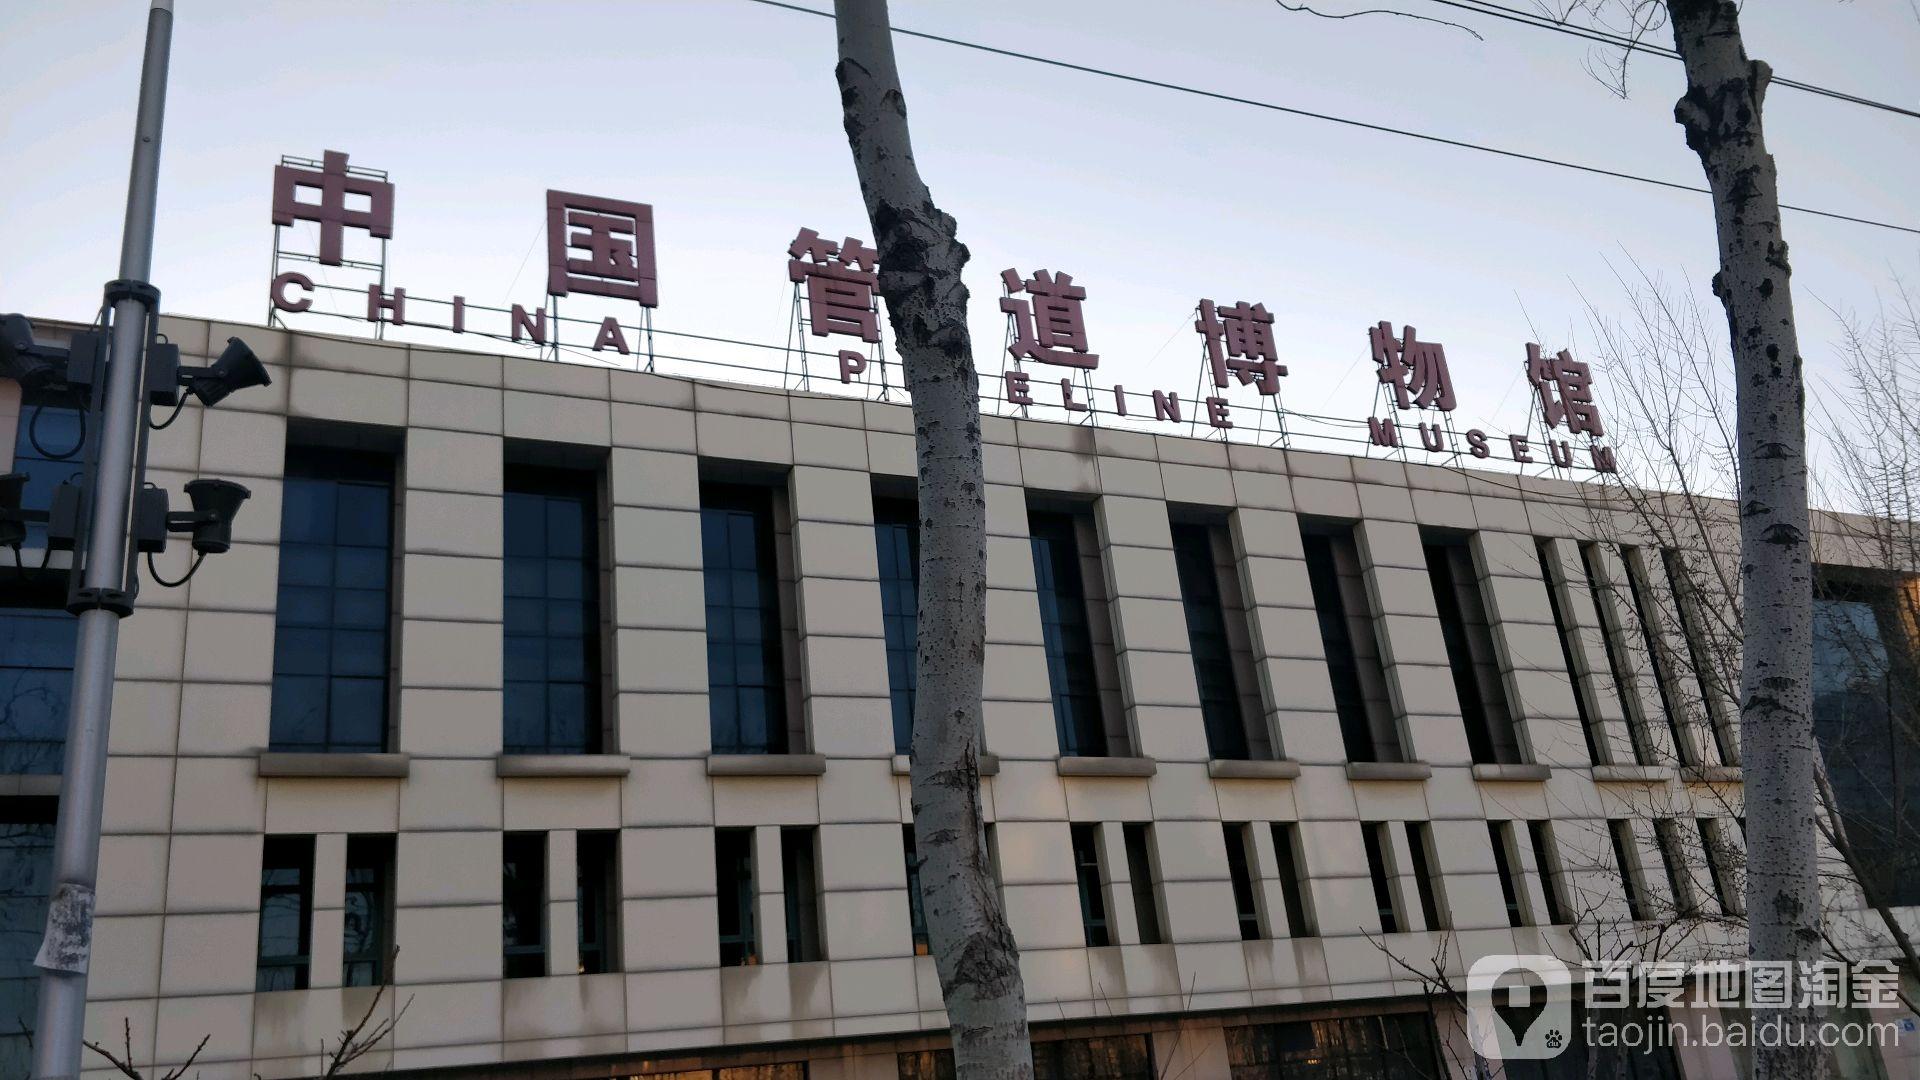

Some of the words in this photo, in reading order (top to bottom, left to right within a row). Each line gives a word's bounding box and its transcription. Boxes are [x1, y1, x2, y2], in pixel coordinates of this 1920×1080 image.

[271, 272, 630, 355] CHINA
[838, 349, 1233, 429] PELINE
[1368, 416, 1616, 473] MUSEUM
[272, 150, 1604, 436] 中国管道博物馆
